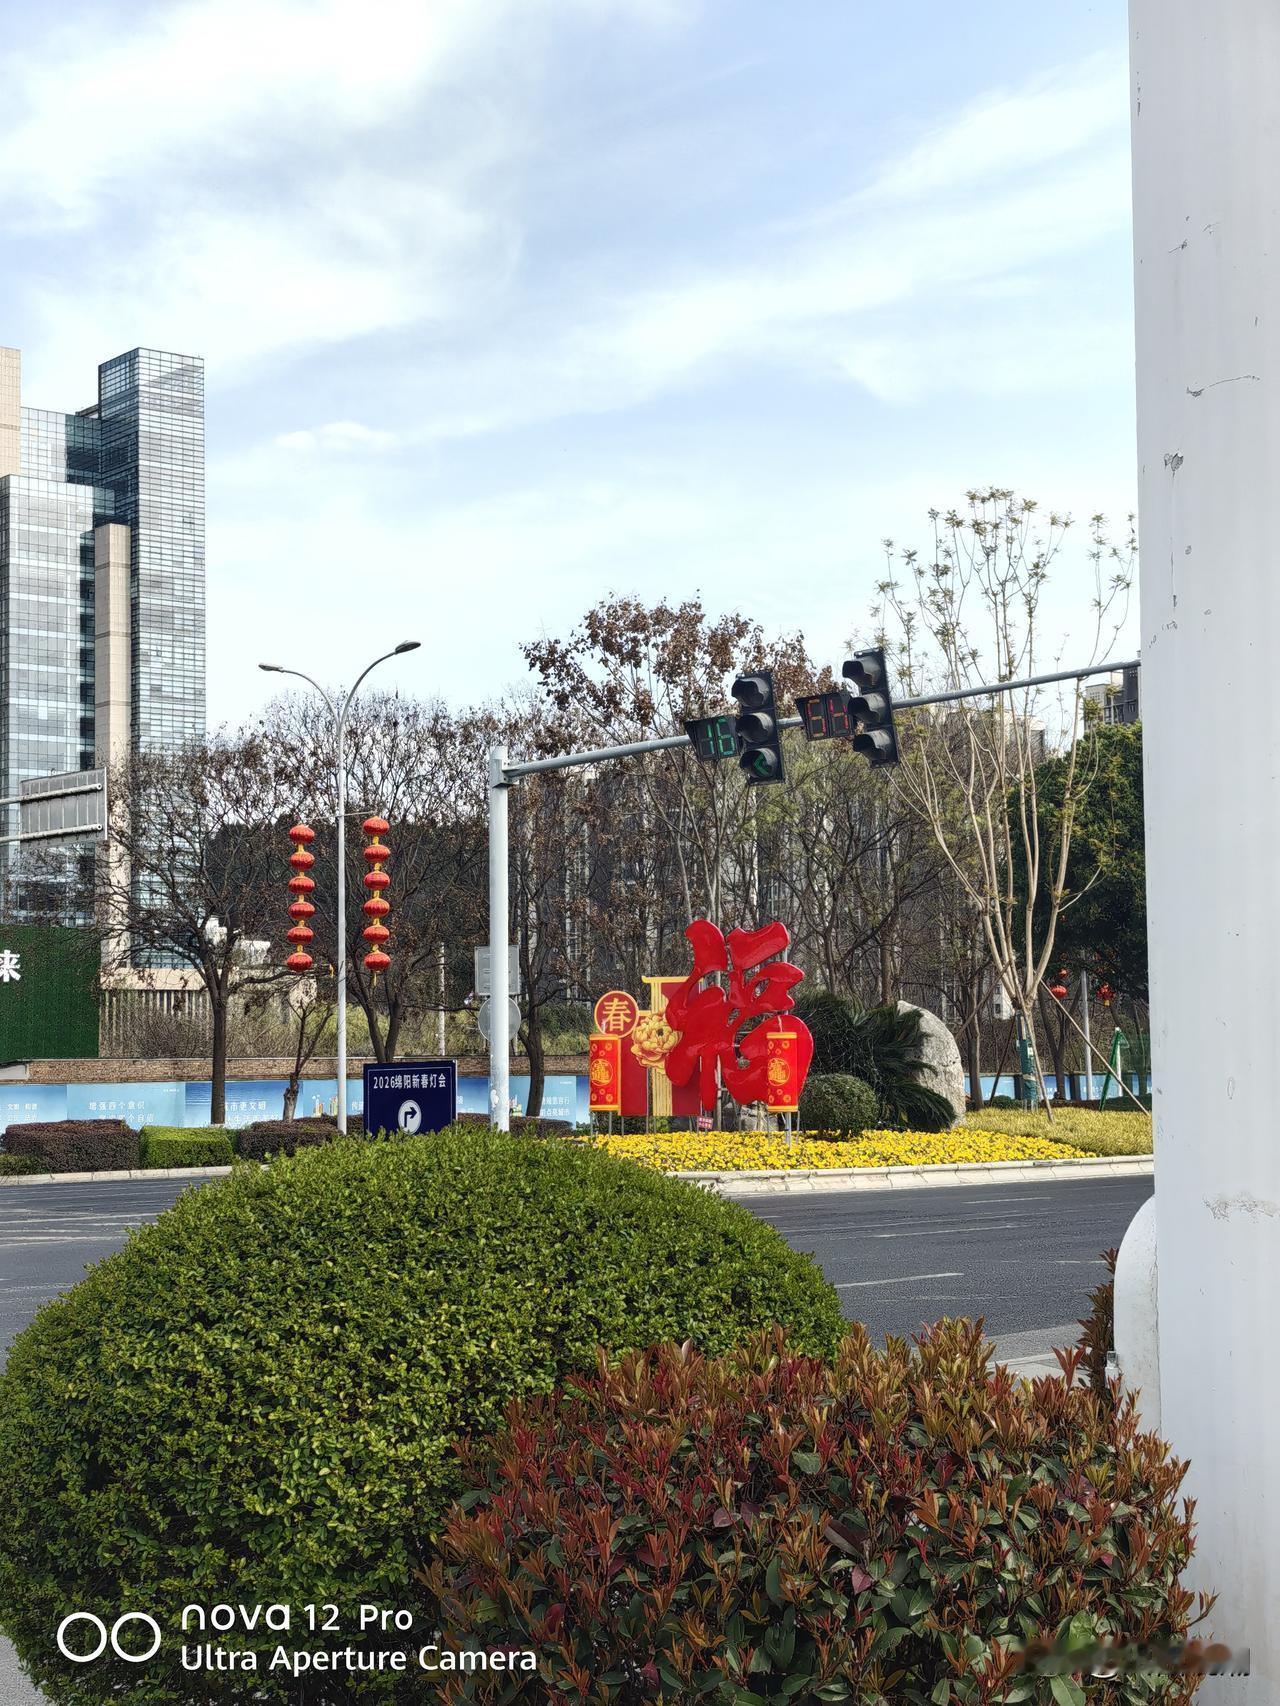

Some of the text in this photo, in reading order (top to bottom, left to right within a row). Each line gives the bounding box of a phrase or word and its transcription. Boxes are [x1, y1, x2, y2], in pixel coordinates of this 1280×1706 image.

[706, 716, 736, 756] 16
[602, 998, 632, 1033] 春
[373, 1073, 446, 1089] 2026绵阳新春灯会
